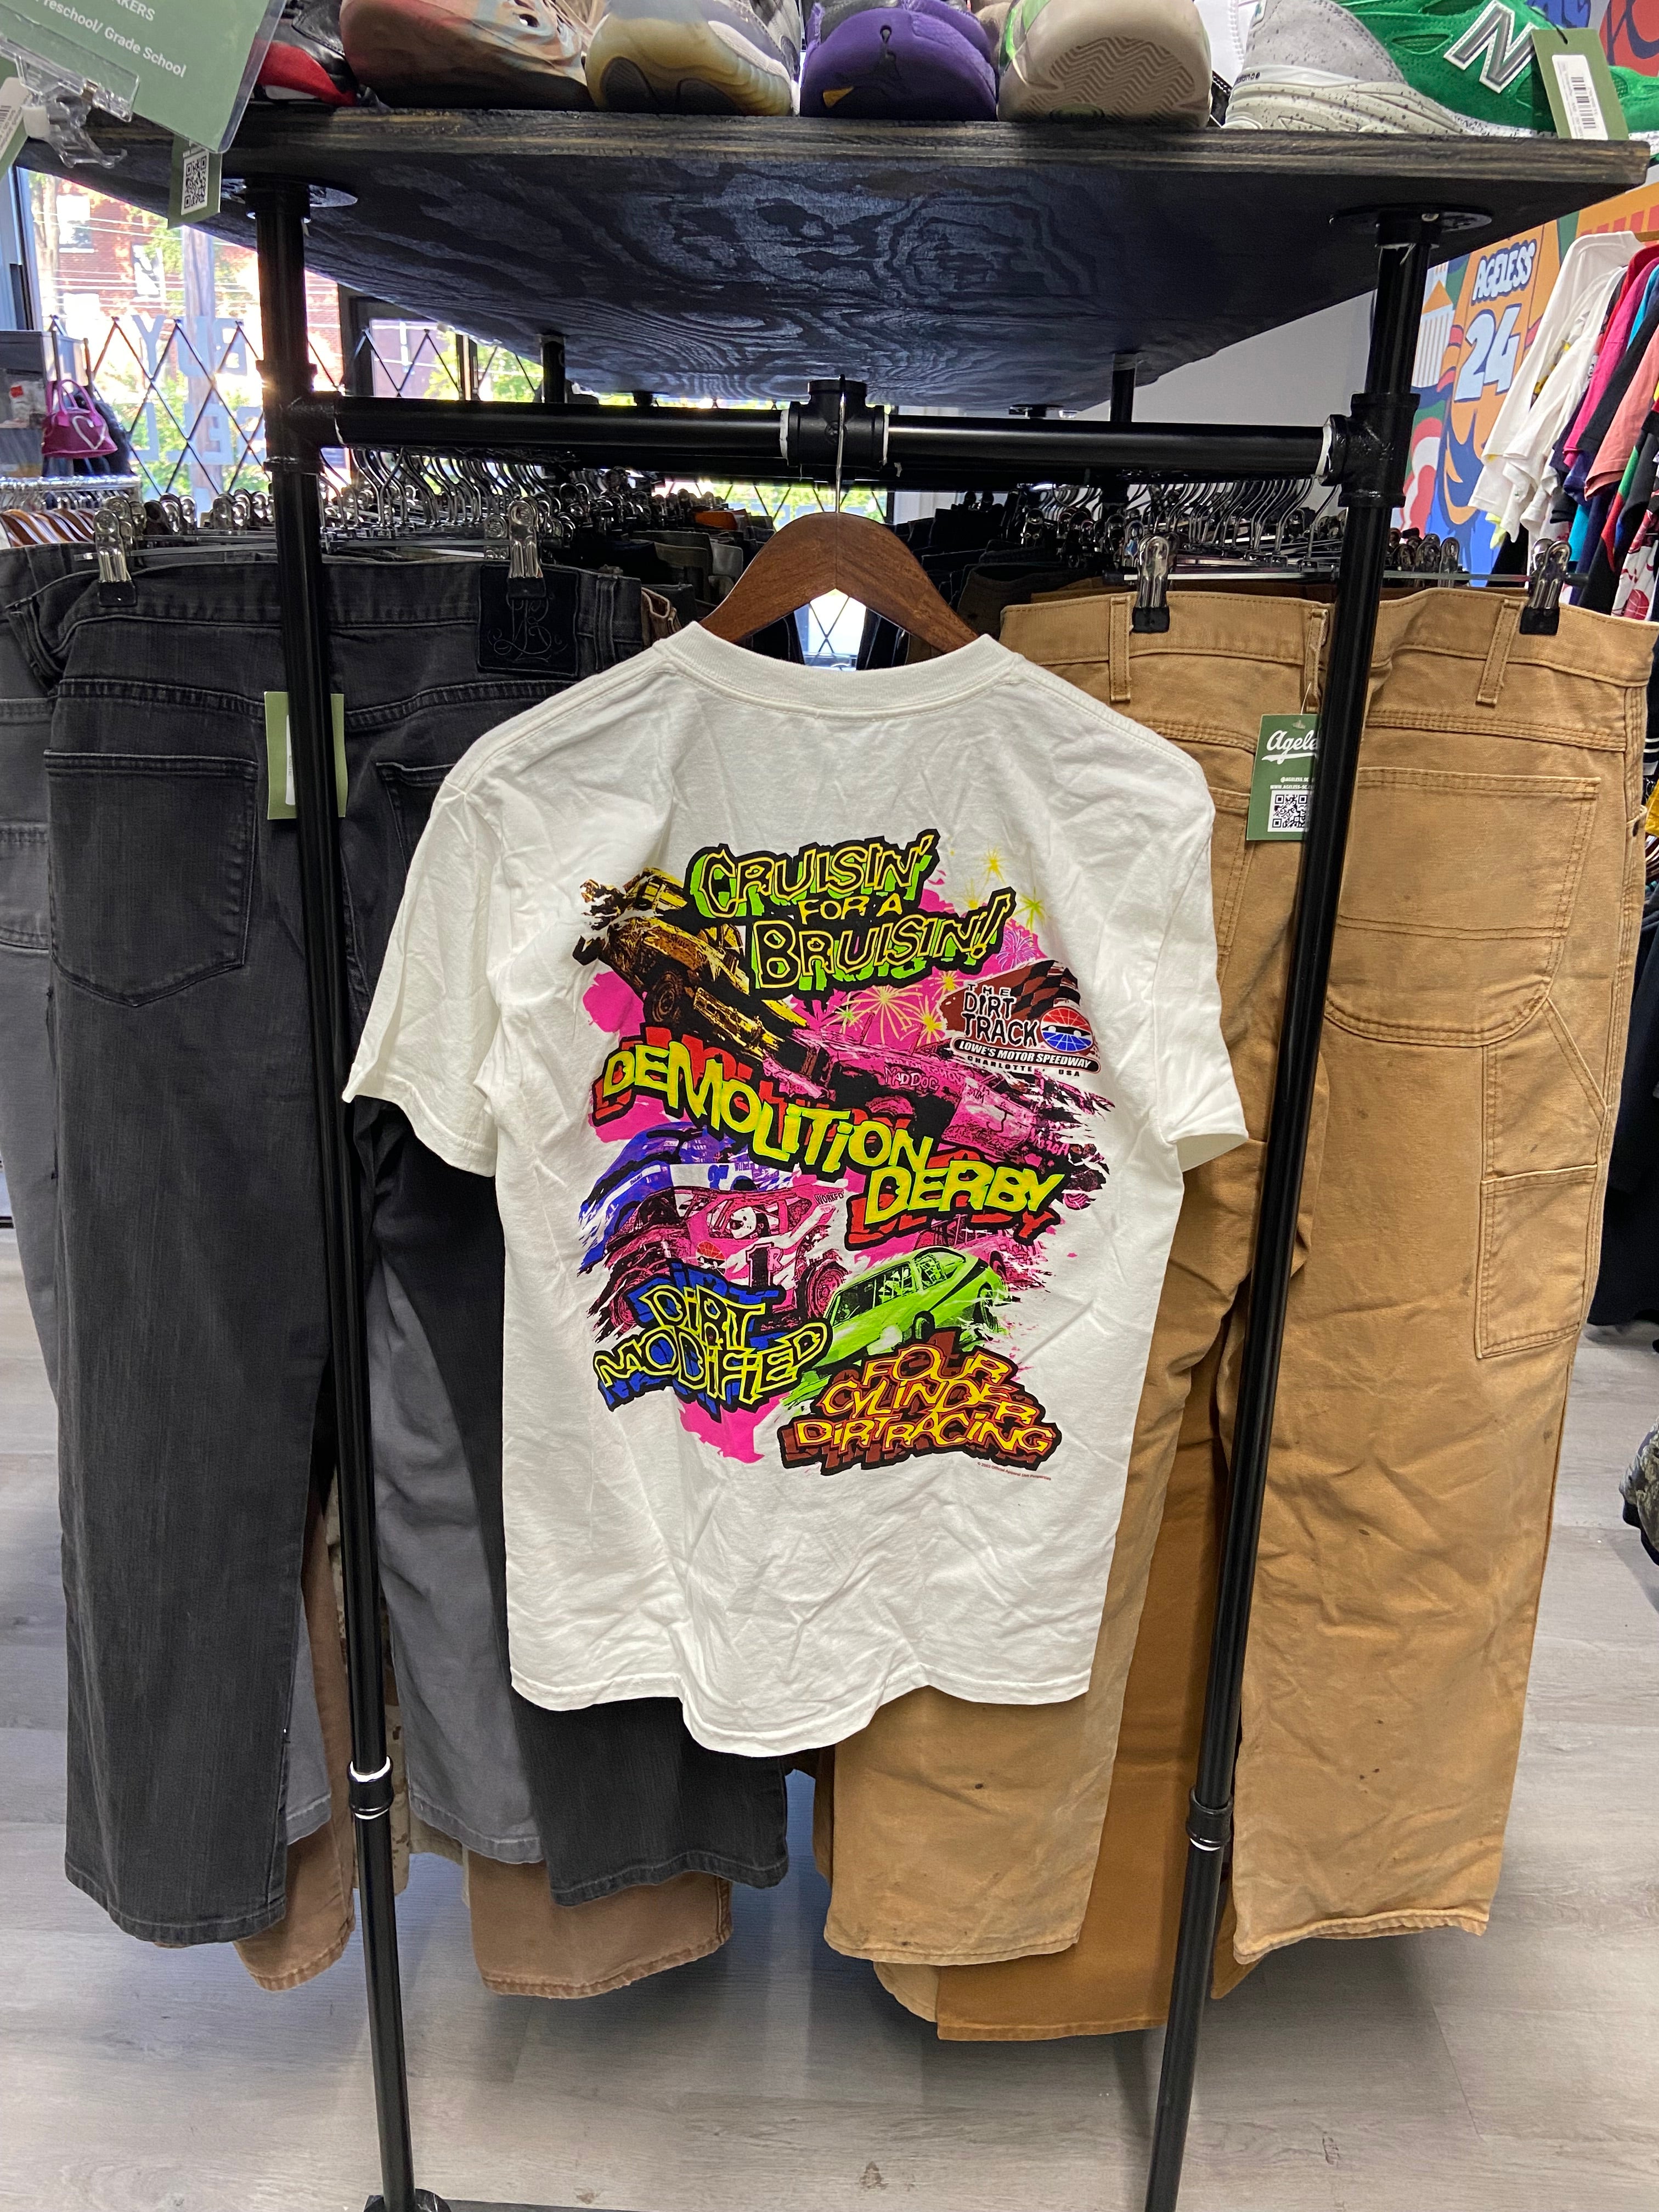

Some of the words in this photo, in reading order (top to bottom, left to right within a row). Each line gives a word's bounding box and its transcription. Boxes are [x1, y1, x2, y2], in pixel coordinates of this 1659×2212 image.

[35, 0, 103, 33] reschool/
[104, 27, 141, 54] Grade
[143, 47, 187, 77] School
[1471, 240, 1536, 304] AGELESS
[1454, 303, 1522, 403] 24
[698, 834, 935, 918] CRUISIN'
[799, 895, 868, 925] FOR
[876, 893, 903, 918] A
[753, 893, 1013, 989] BRUISIN!
[963, 991, 1015, 1020] DIRT
[968, 984, 1011, 996] THE
[961, 1013, 1039, 1047] TRACK
[959, 1040, 996, 1058] LOWE'S
[997, 1050, 1035, 1063] MOTOR
[1035, 1053, 1092, 1069] SPEEDWAY
[967, 1056, 1032, 1072] CHARLOTTE
[866, 1160, 1065, 1224] DERBY
[862, 1344, 1012, 1386] FOUR
